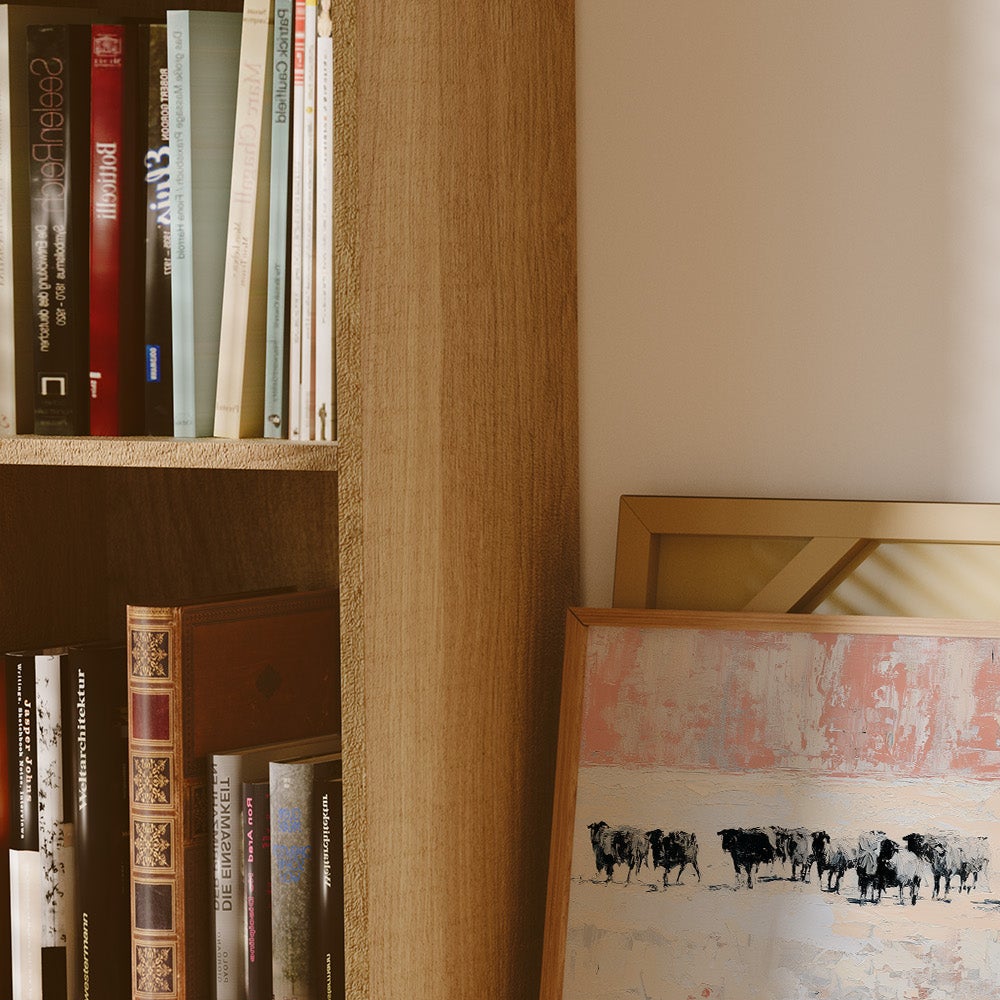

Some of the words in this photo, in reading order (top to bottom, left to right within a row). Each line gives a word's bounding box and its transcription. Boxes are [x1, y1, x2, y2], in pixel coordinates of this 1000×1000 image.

[23, 699, 32, 752] Jasper
[76, 668, 88, 811] Weltarchitektur
[25, 756, 33, 803] Johns
